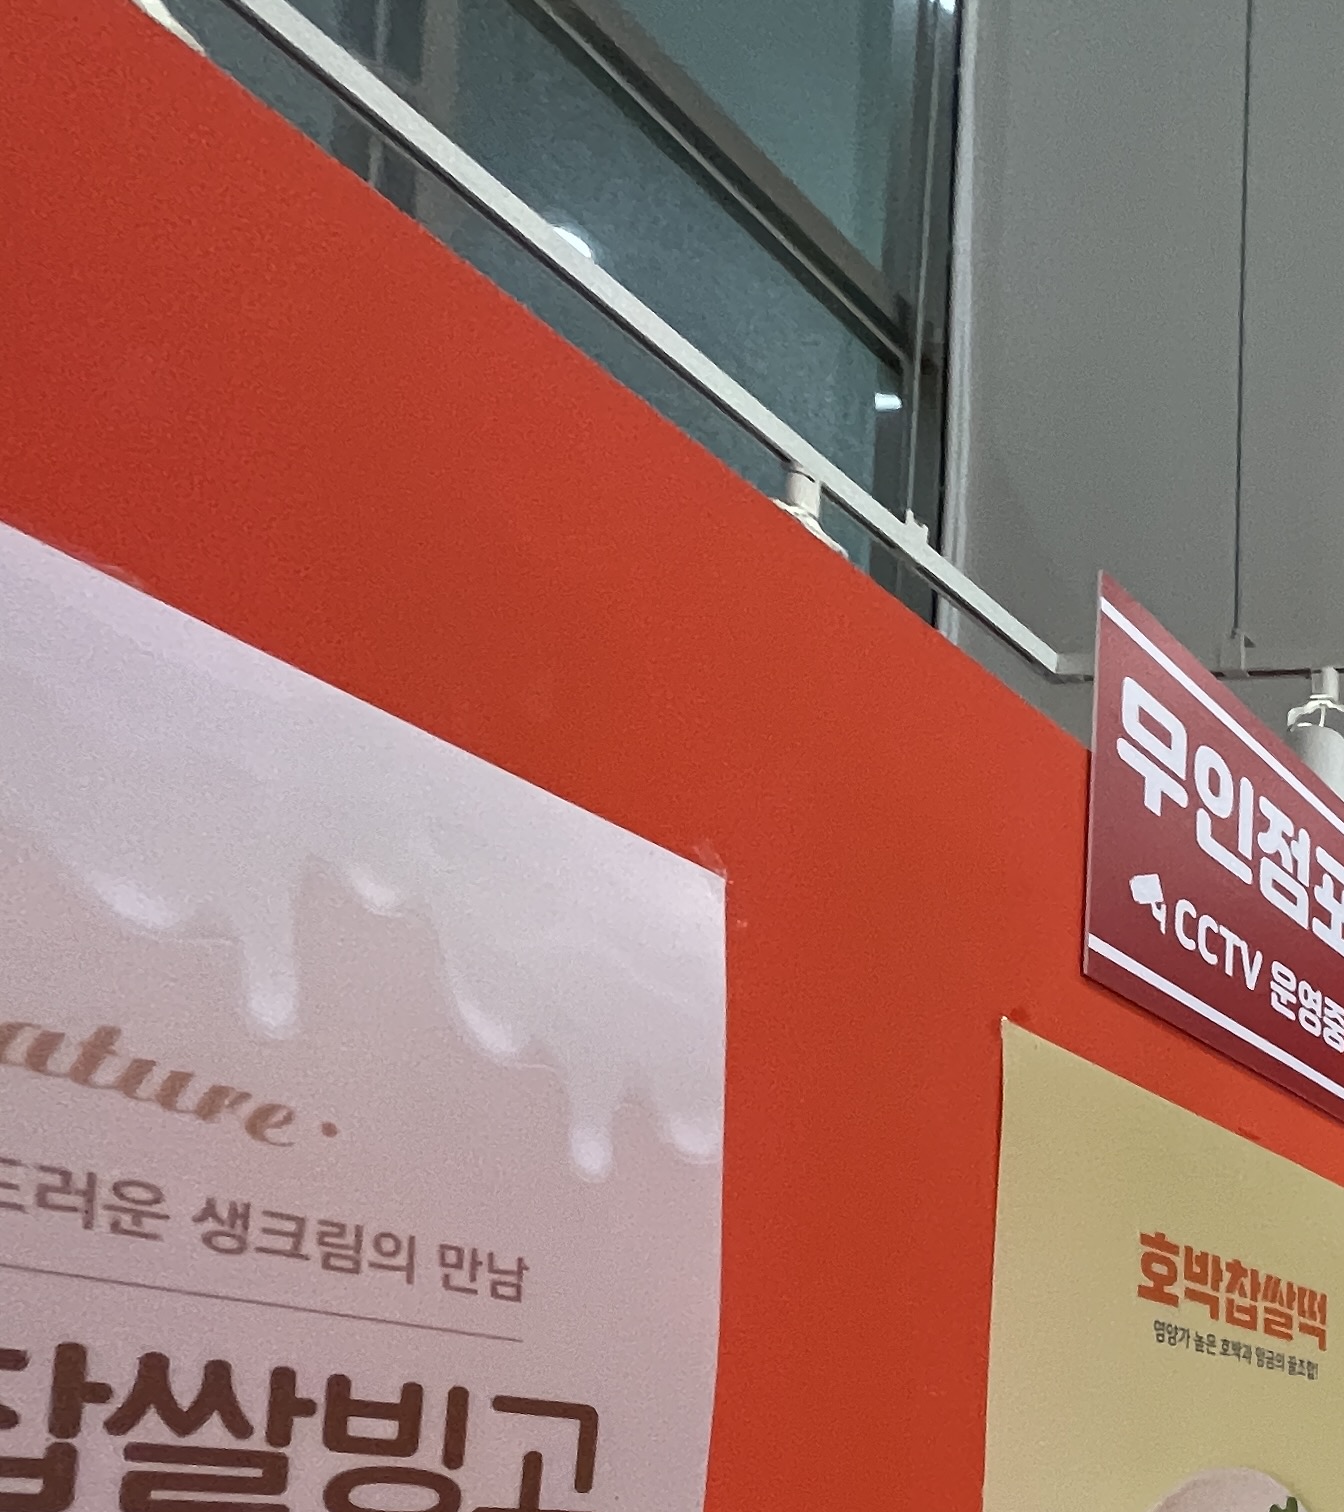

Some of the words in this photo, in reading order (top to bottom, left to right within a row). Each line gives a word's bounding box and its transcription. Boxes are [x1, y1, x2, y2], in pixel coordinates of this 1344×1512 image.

[1174, 899, 1262, 991] CCTV
[191, 1197, 417, 1285] 생크림의
[436, 1242, 531, 1304] 만남
[1137, 1231, 1328, 1352] 호박찹쌀떡
[1153, 1319, 1191, 1349] 영양가
